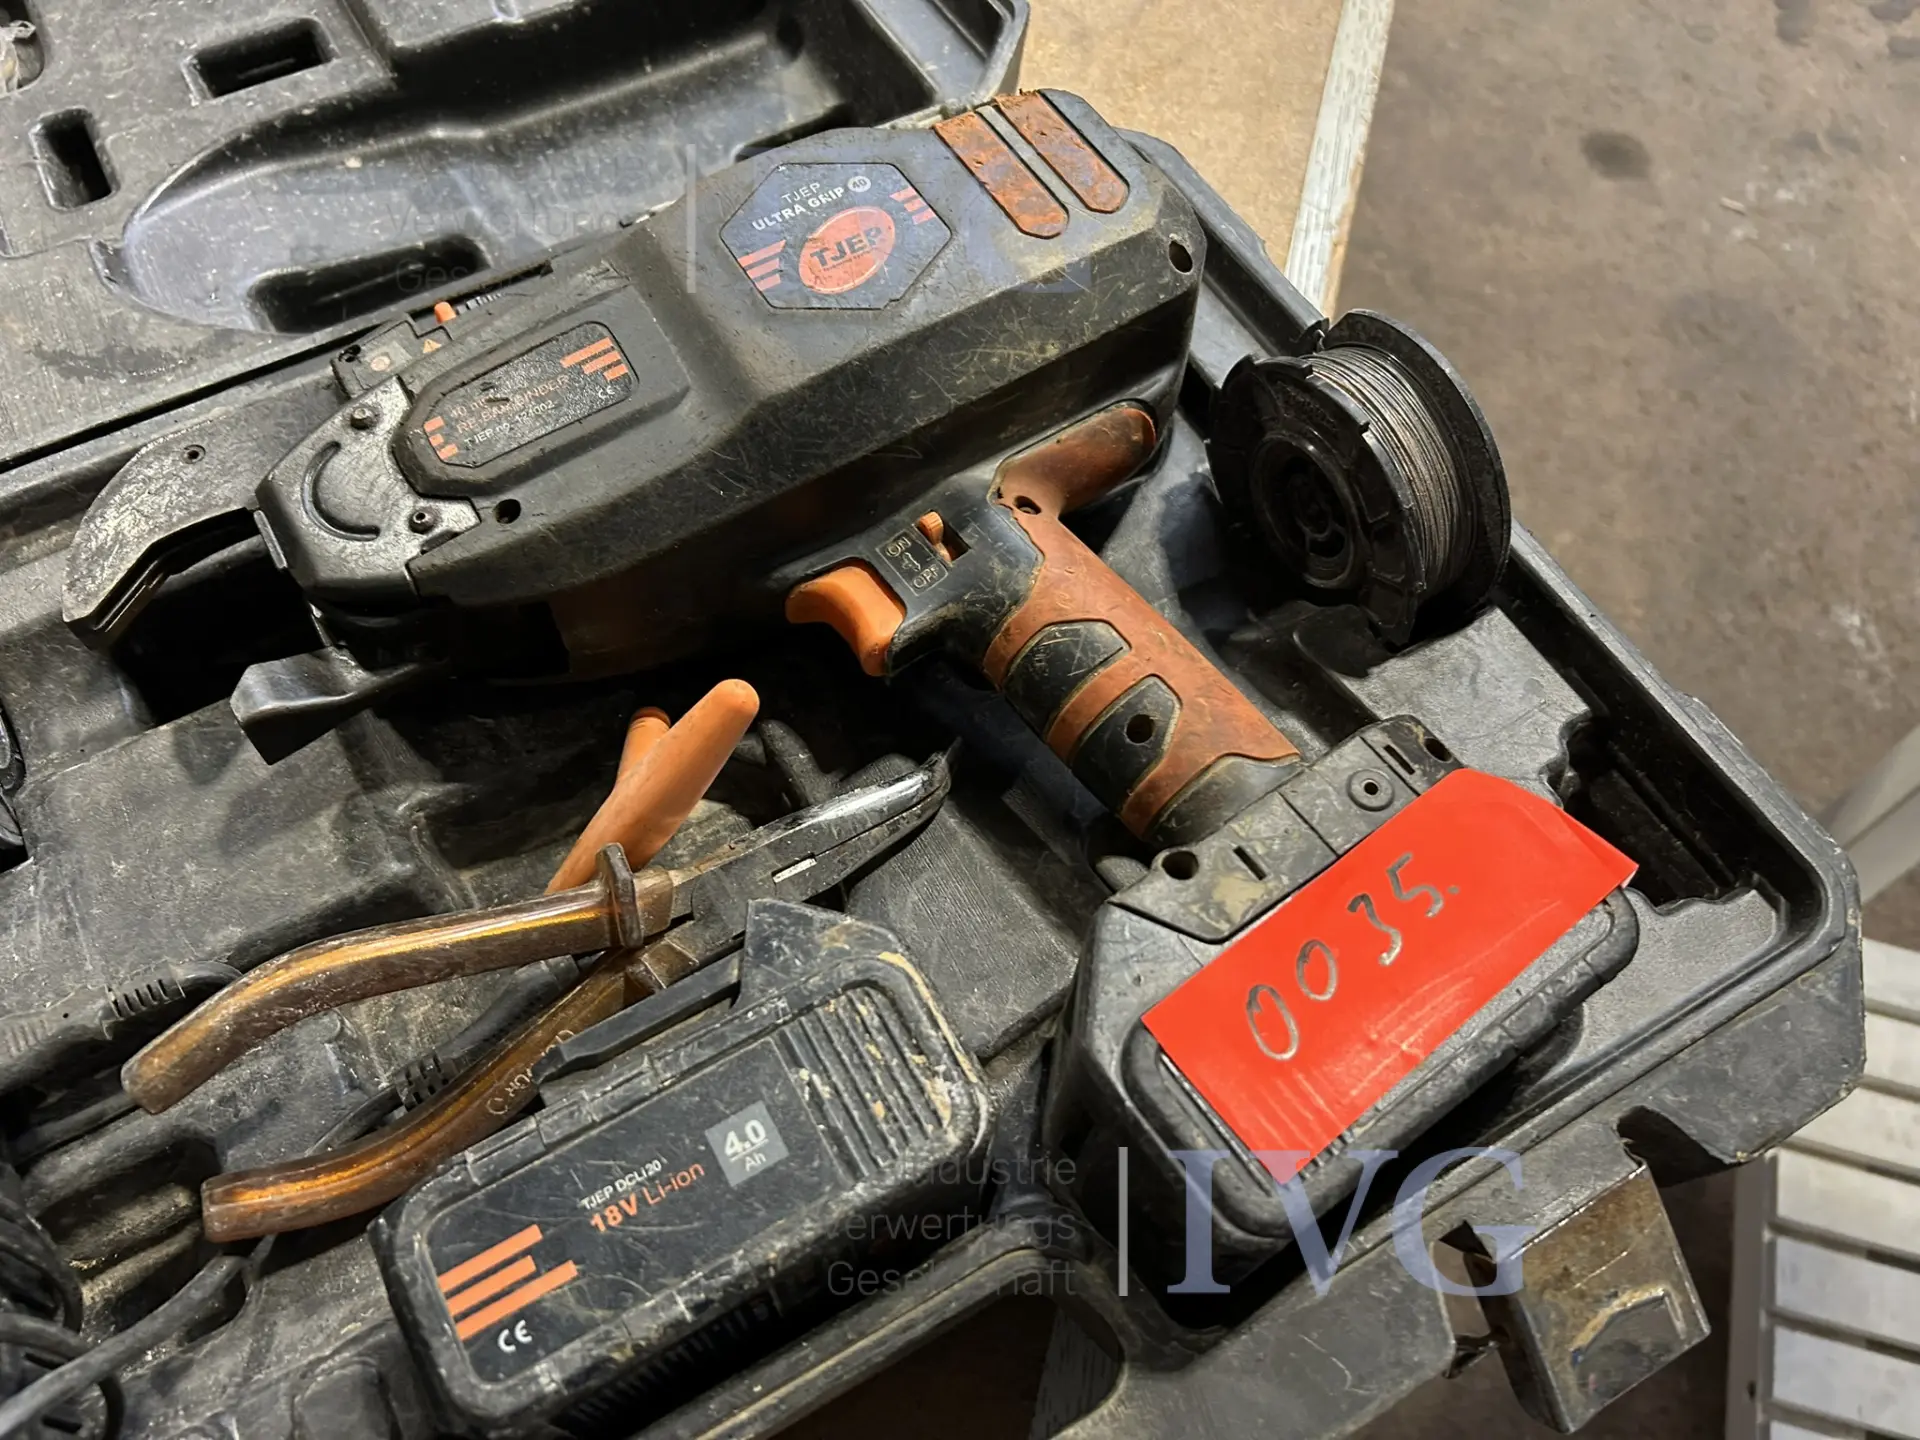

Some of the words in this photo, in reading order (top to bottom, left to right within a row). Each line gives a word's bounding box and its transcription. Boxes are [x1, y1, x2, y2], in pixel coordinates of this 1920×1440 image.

[751, 203, 809, 232] ULTRA
[807, 186, 846, 209] GRIP
[851, 178, 868, 189] 40
[782, 182, 822, 204] TJEP
[810, 226, 883, 268] TJEP
[886, 536, 911, 557] ON
[724, 1118, 767, 1158] 4.0
[744, 1152, 767, 1172] Ah
[580, 1185, 614, 1210] TJEP
[589, 1192, 639, 1234] 18V
[641, 1163, 705, 1206] Li-ion
